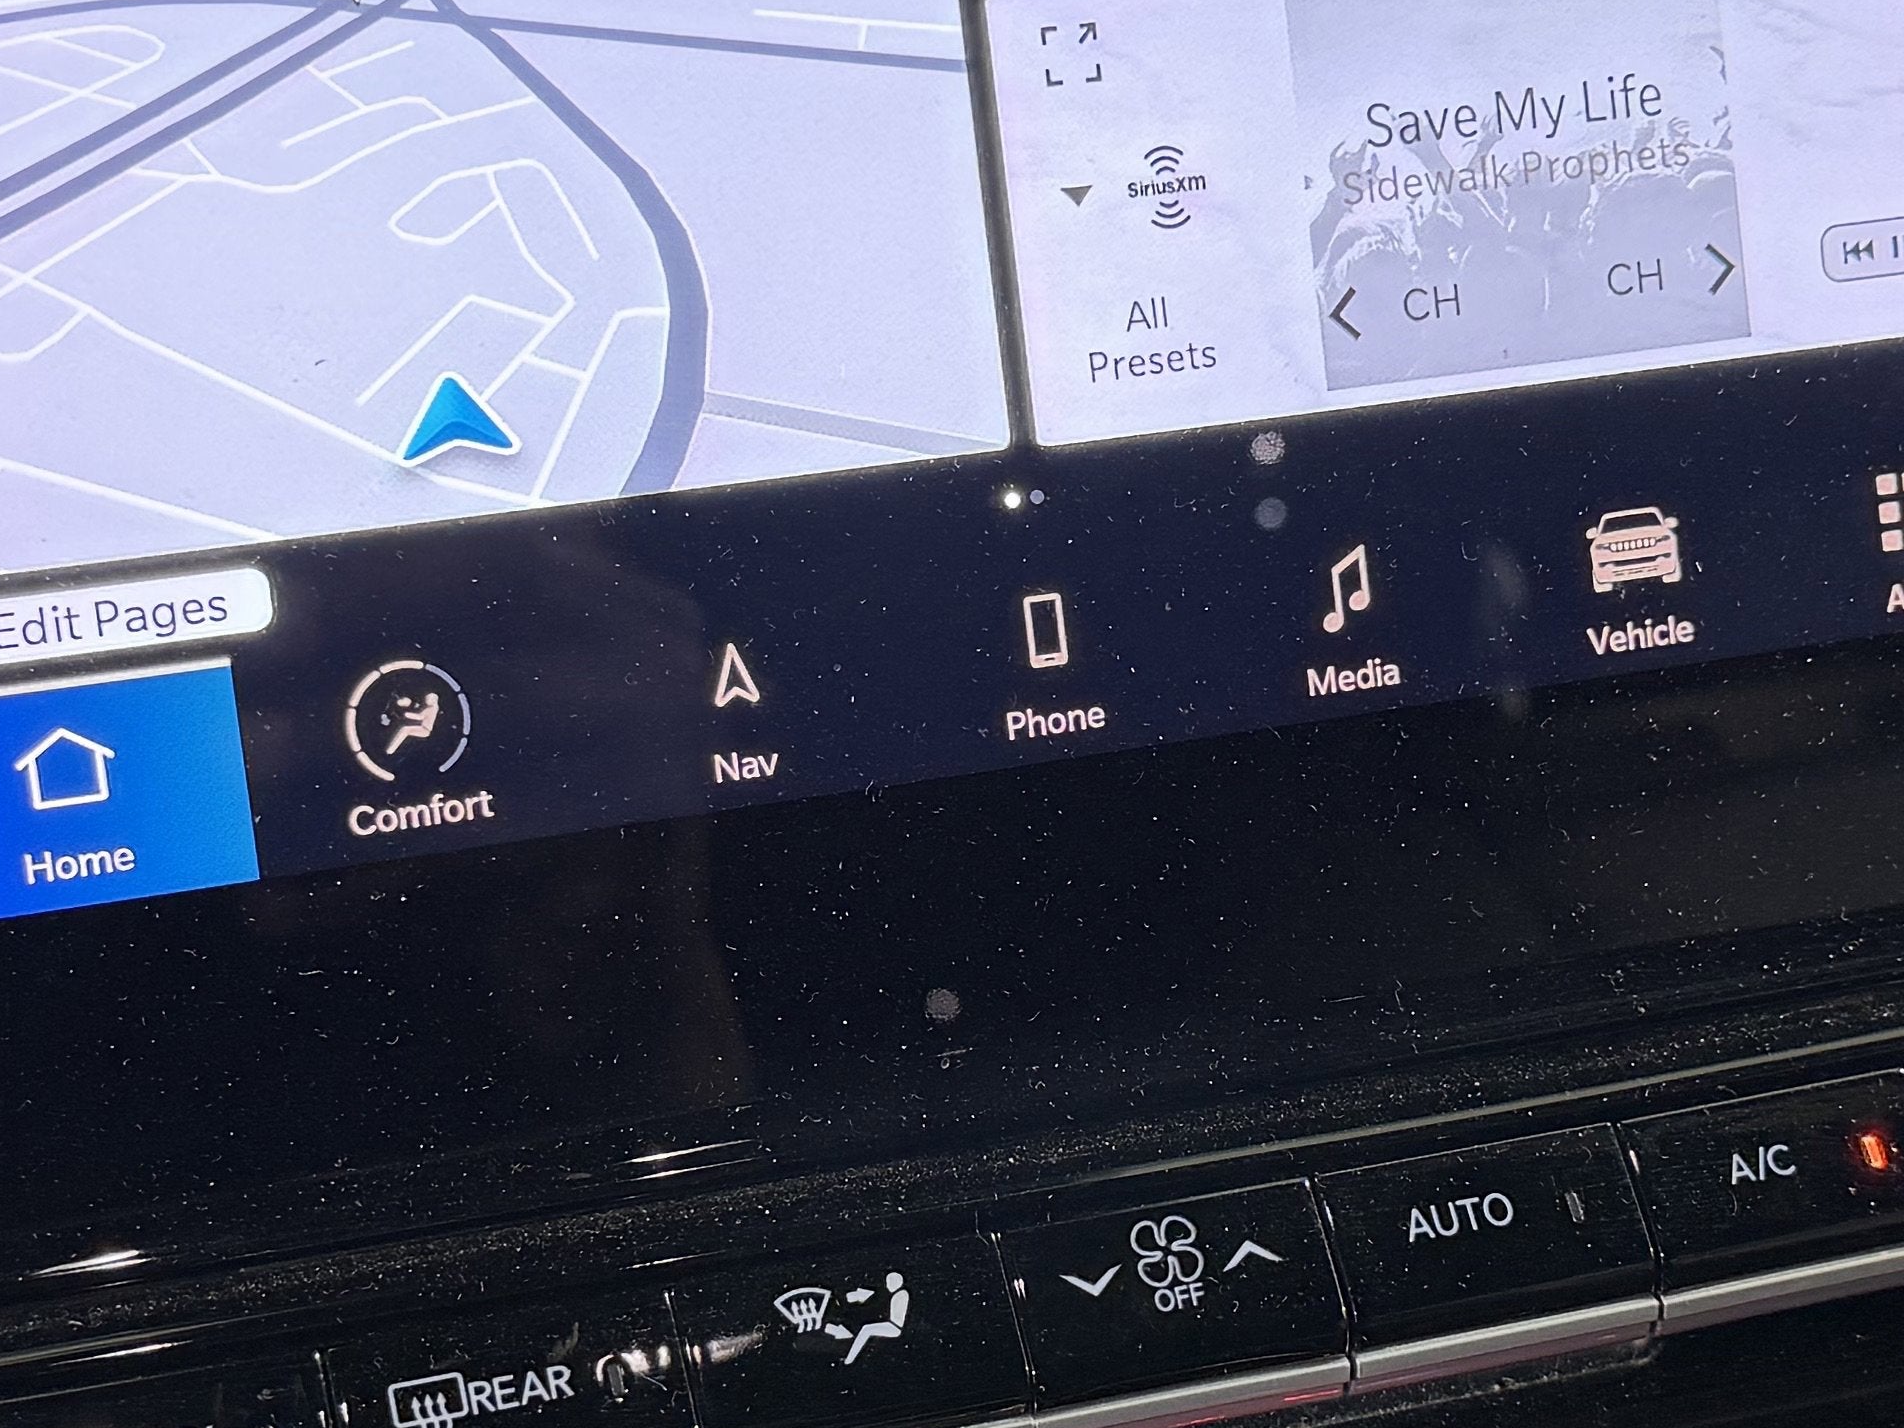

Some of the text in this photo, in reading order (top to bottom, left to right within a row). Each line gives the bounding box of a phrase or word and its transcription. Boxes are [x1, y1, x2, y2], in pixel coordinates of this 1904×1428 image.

[1366, 73, 1662, 148] Save My Life
[1342, 137, 1692, 206] Sidewalk Prophets
[1607, 258, 1664, 296] CH
[1126, 296, 1168, 333] All
[1403, 283, 1461, 322] CH
[1088, 342, 1217, 383] Presets
[94, 596, 228, 638] Pages
[1586, 615, 1695, 656] Vehicle
[1306, 657, 1401, 697] Media
[1006, 706, 1106, 741] Phone
[713, 751, 779, 784] Nav
[348, 790, 495, 836] Comfort
[23, 841, 135, 885] Home
[1731, 1144, 1797, 1185] A/C
[1408, 1192, 1514, 1243] AUTO
[1154, 1282, 1205, 1312] OFF
[467, 1365, 575, 1416] REAR
